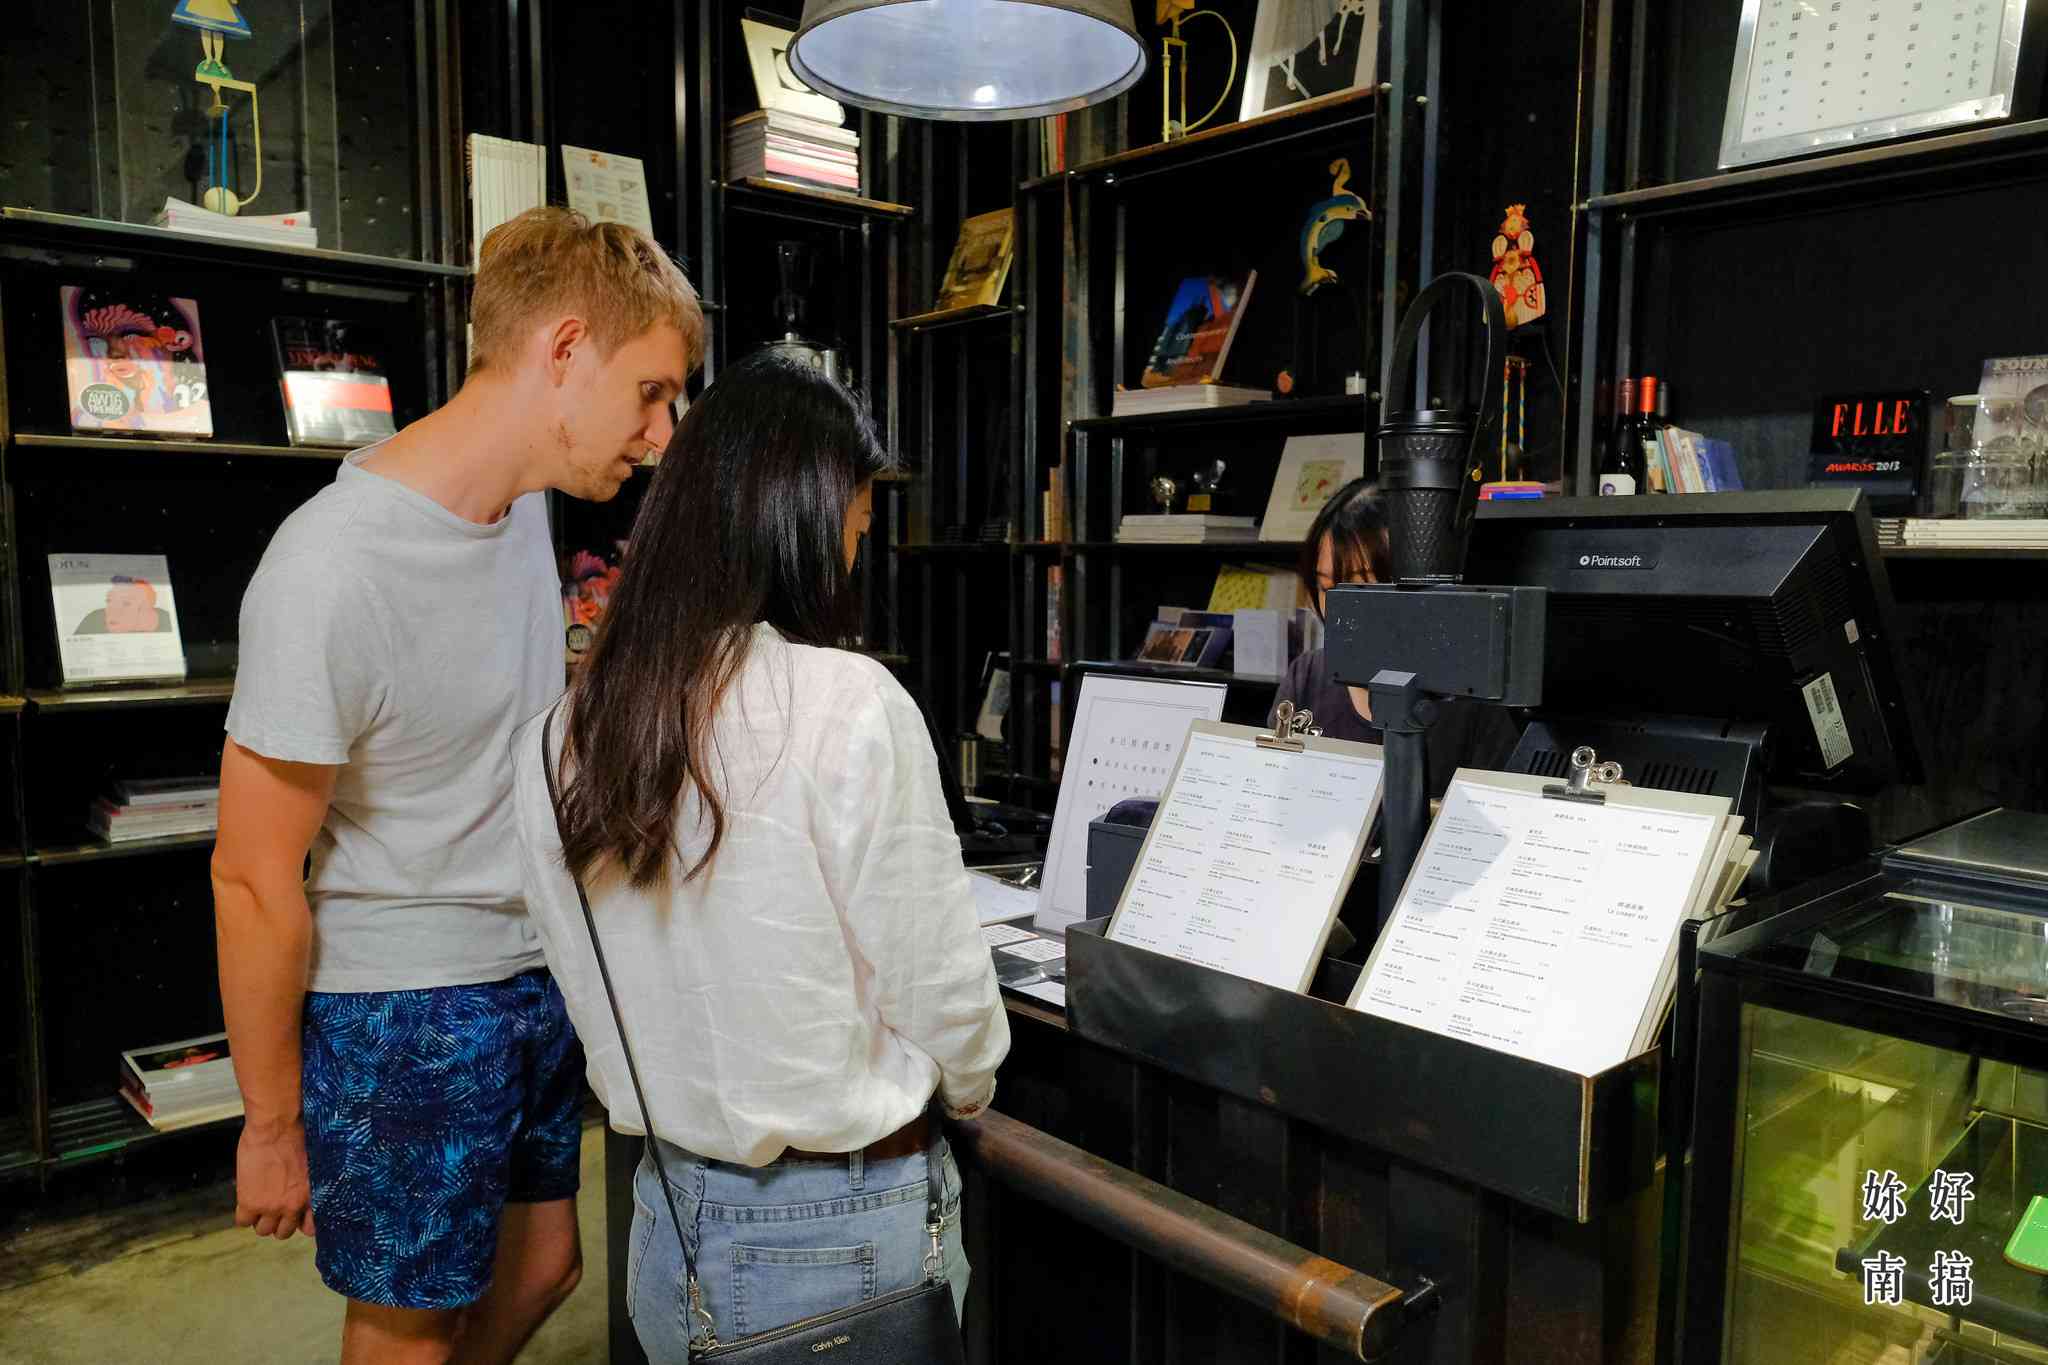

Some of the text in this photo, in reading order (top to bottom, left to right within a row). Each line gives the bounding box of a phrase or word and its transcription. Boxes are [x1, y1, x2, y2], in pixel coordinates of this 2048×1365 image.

[1831, 400, 1911, 437] ELLE
[1825, 461, 1901, 473] AWARDS 2013
[1591, 554, 1642, 567] Pointsoft
[811, 1341, 833, 1353] Calvin
